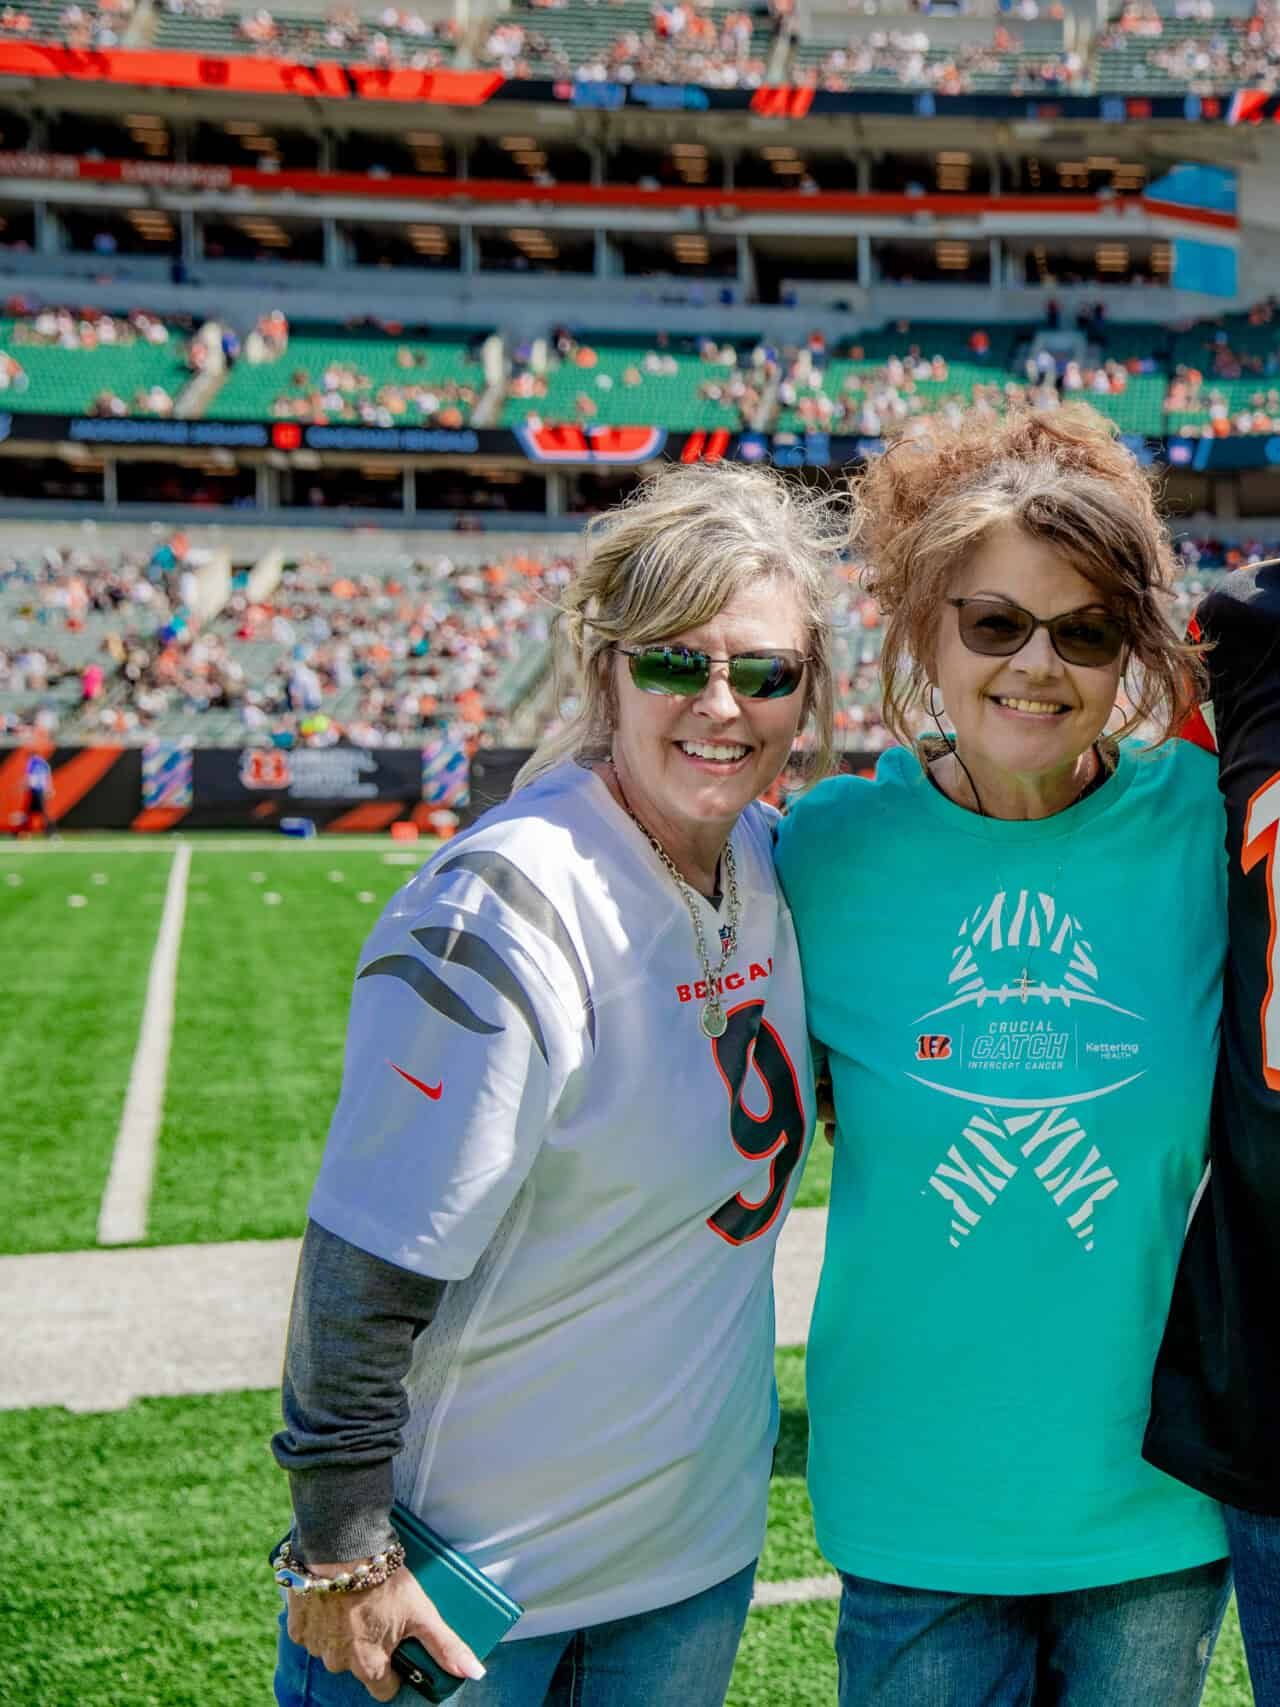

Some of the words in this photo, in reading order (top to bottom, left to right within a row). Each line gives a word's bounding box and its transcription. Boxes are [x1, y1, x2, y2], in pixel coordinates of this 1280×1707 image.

[988, 1020, 1055, 1034] CRUCIAL
[971, 1033, 1069, 1061] CATCH
[1086, 1042, 1140, 1054] Kettering
[967, 1061, 1021, 1071] INTERCEPT
[1025, 1061, 1064, 1071] CANCER
[706, 1000, 806, 1247] 9
